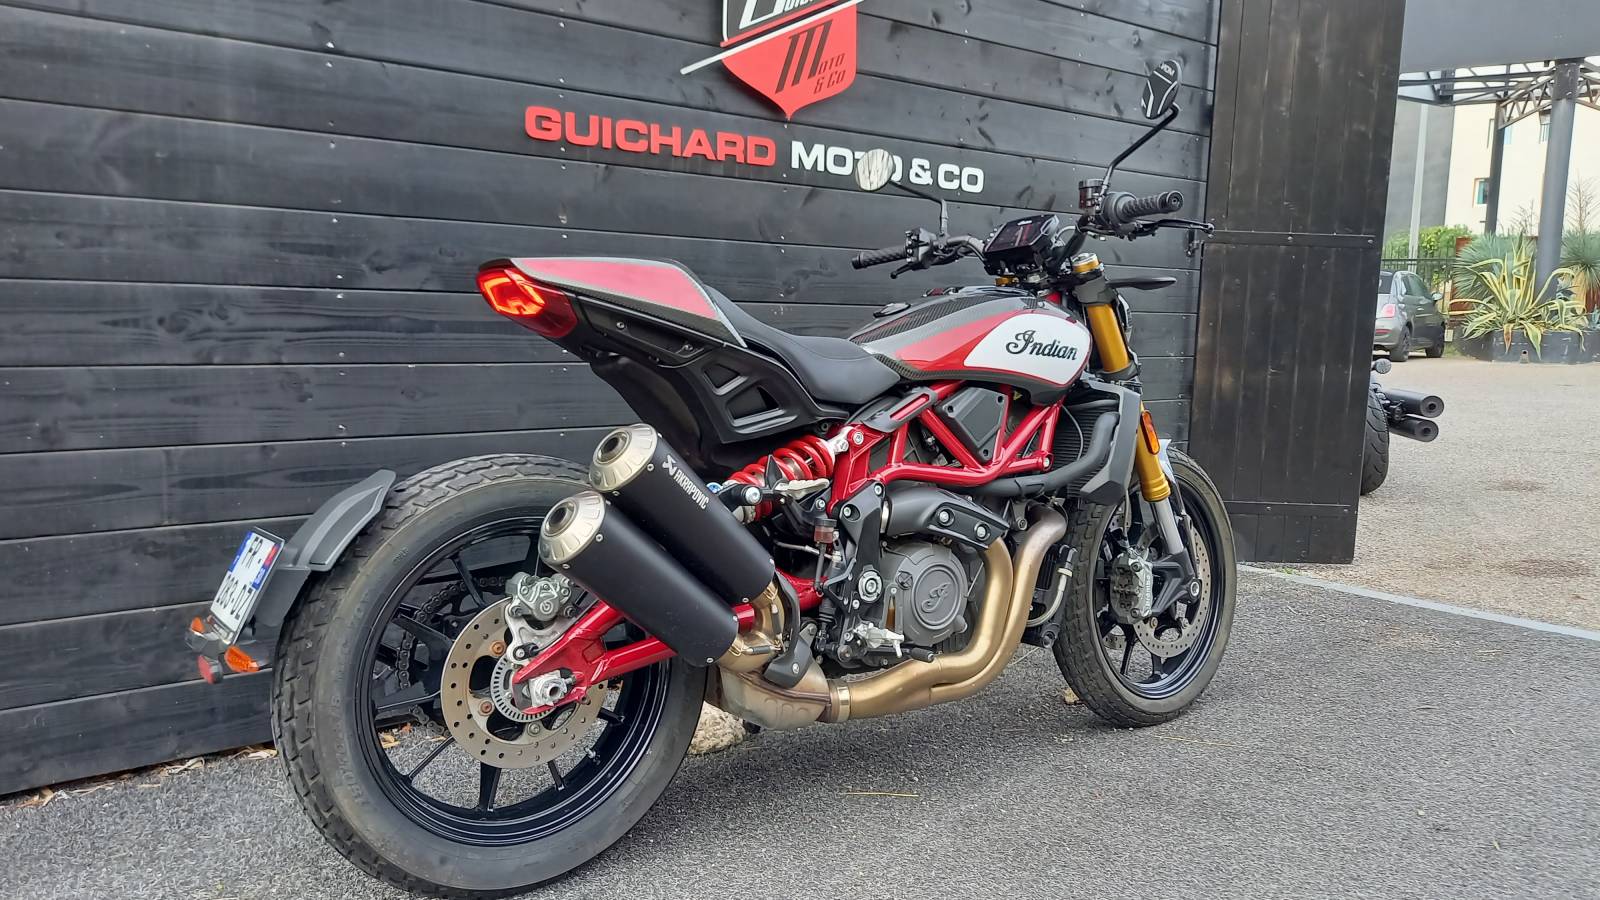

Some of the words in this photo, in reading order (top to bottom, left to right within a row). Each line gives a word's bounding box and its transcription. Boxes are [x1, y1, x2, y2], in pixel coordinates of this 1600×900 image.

[524, 106, 776, 167] GUICHARD
[791, 140, 903, 182] MO
[1005, 330, 1078, 361] Indian
[673, 467, 710, 510] AKRAPOVIC
